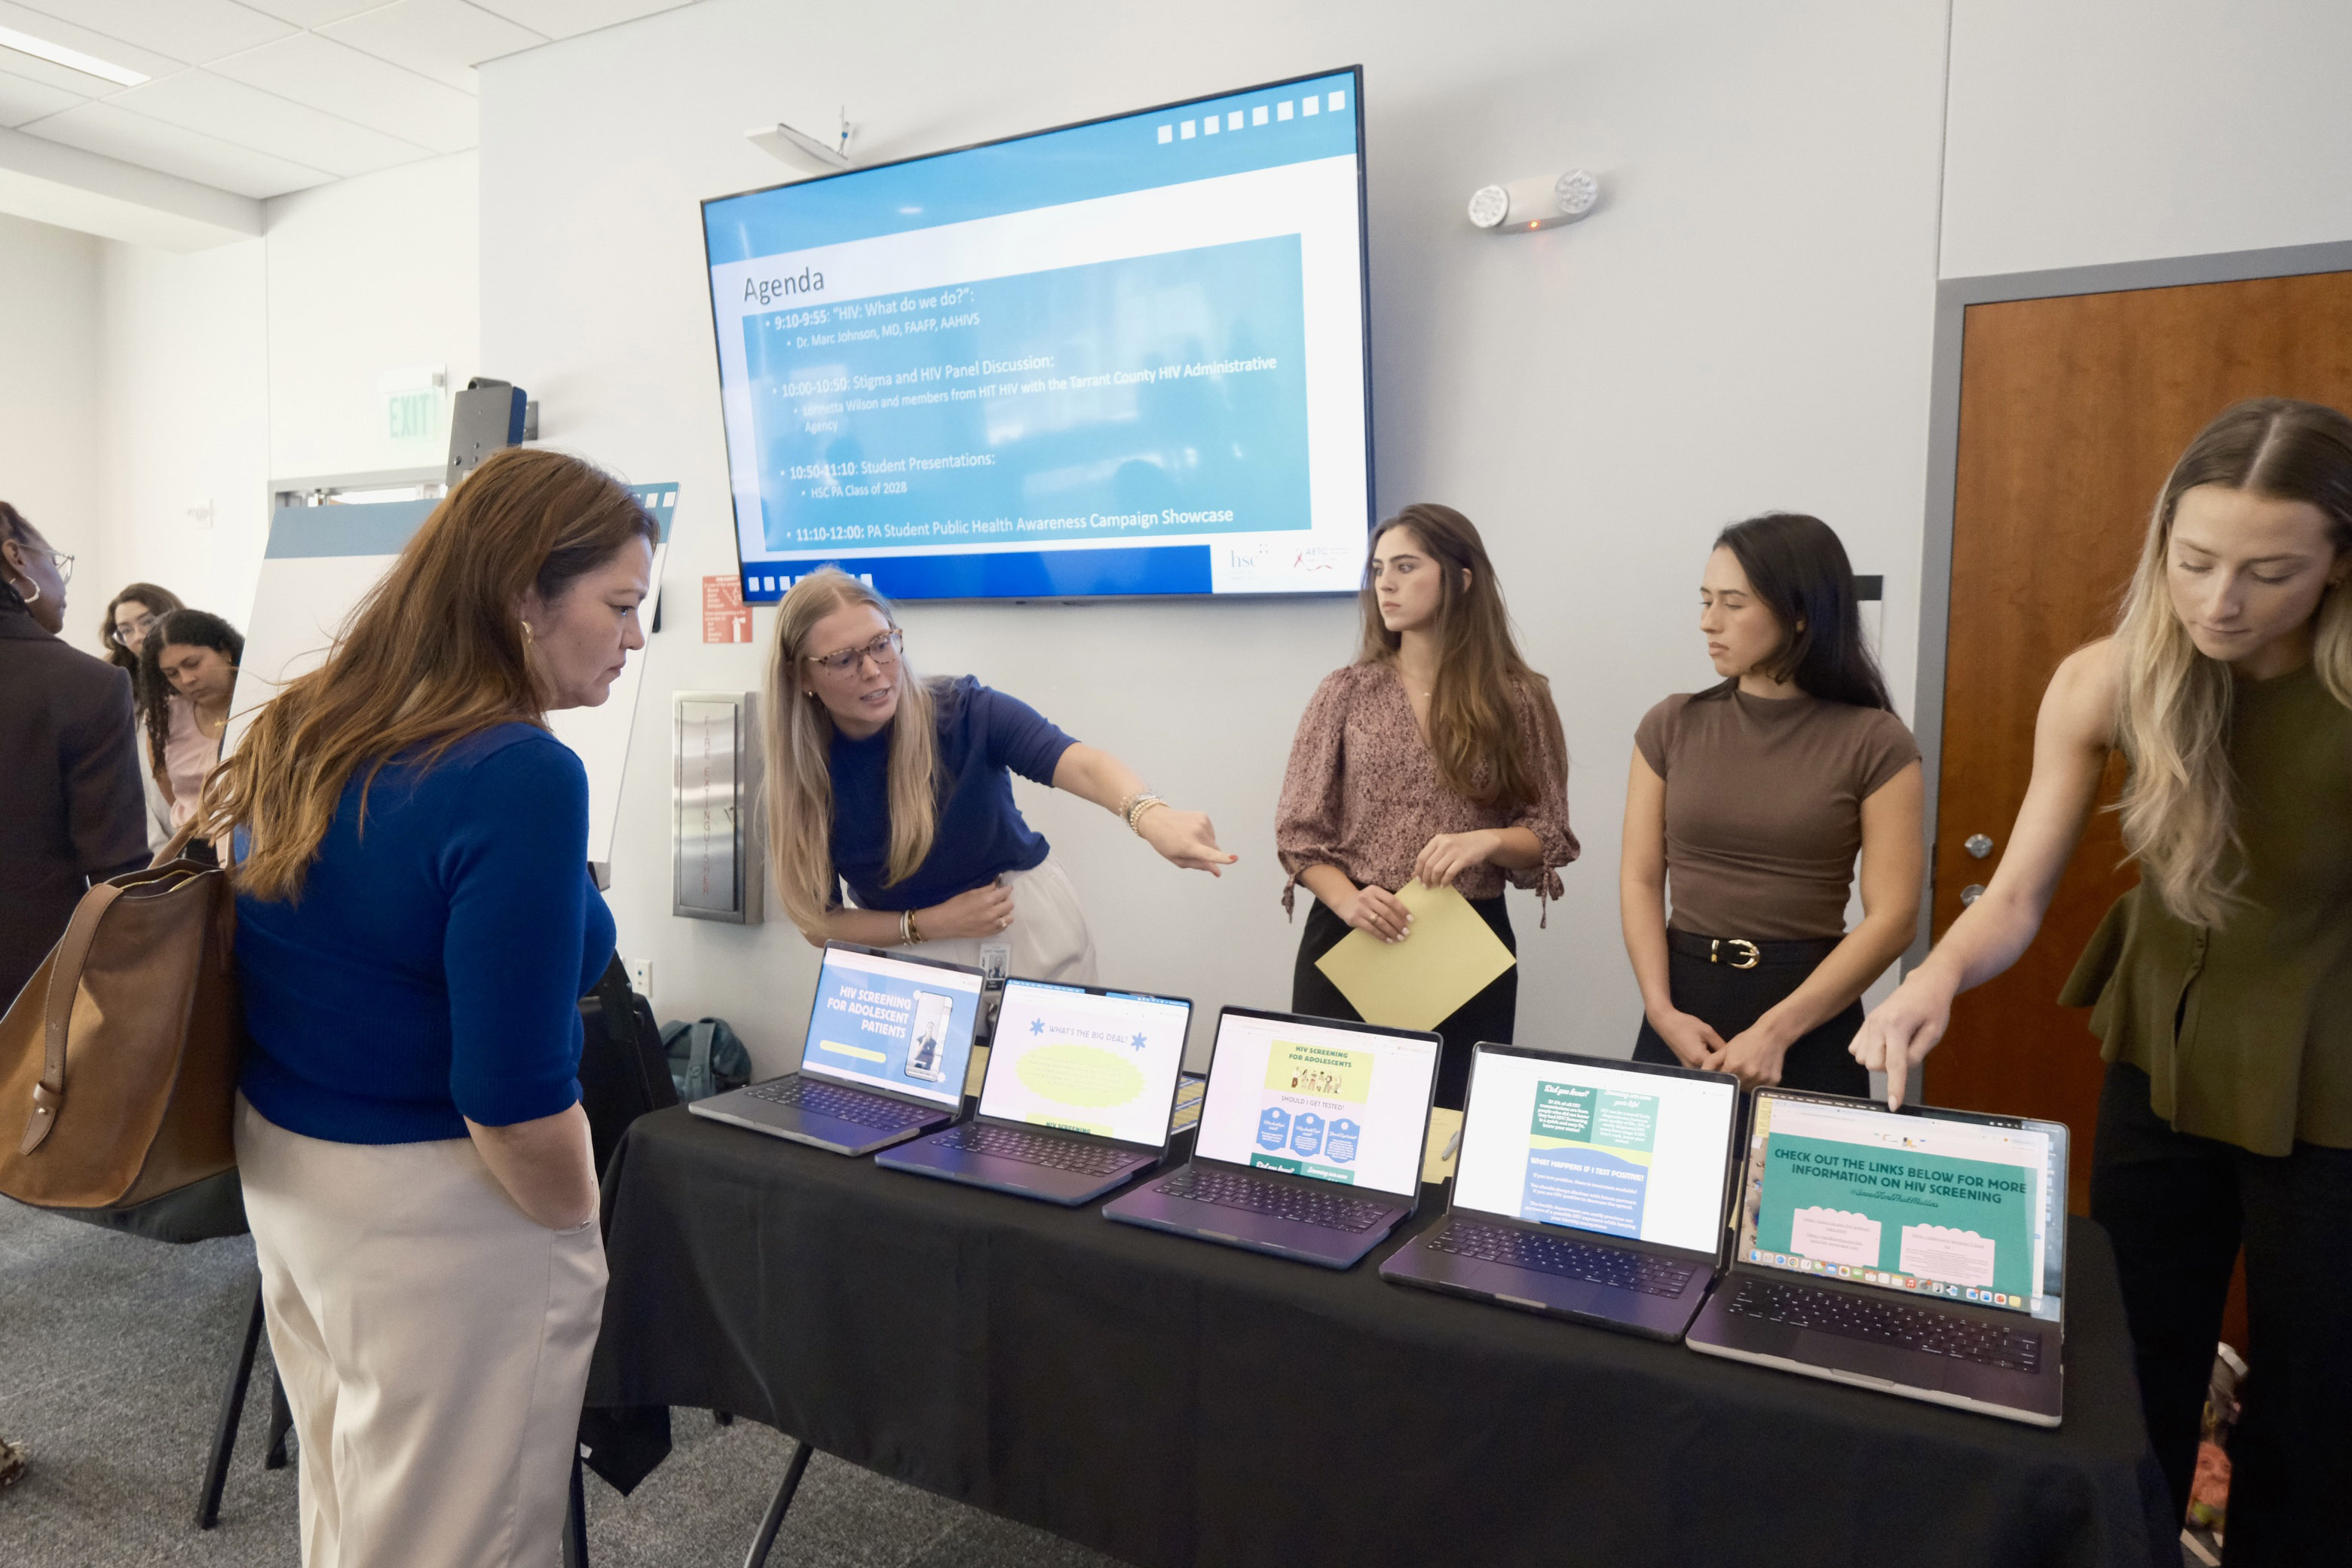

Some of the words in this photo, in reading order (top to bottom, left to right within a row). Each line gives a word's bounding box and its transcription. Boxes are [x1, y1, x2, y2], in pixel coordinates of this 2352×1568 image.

[744, 266, 824, 305] Agenda
[775, 310, 830, 331] 9:10-9:55:
[865, 301, 897, 317] What
[901, 296, 917, 312] do
[920, 297, 937, 310] we
[797, 336, 810, 349] Dr.
[812, 334, 835, 347] Marc
[838, 329, 880, 344] Johnson,
[882, 323, 902, 338] MD,
[905, 318, 939, 334] FAAFP,
[941, 312, 980, 329] AAHIVS
[782, 376, 850, 398] 10:00-10:50:
[853, 373, 892, 391] Stigma
[896, 367, 917, 384] and
[920, 365, 942, 381] HIV
[945, 360, 979, 379] Panel
[982, 355, 1055, 375] Discussion:
[846, 398, 879, 411] Wilson
[880, 394, 899, 408] and
[902, 389, 949, 406] members
[951, 387, 976, 400] from
[978, 384, 997, 398] HIT
[999, 382, 1018, 396] HIV
[1021, 380, 1046, 394] with
[1048, 377, 1067, 391] the
[1070, 372, 1111, 389] Tarrant
[1113, 369, 1156, 385] County
[1159, 365, 1181, 380] HIV
[1184, 356, 1277, 378] Administrative
[389, 393, 430, 439] EXIT
[805, 420, 838, 435] Agency
[790, 462, 858, 480] 10:50-11:10:
[861, 458, 905, 475] Student
[909, 453, 995, 471] Presentations:
[811, 486, 830, 499] HSC
[831, 485, 844, 498] PA
[846, 483, 868, 497] Class
[871, 482, 882, 495] of
[884, 481, 908, 495] 2028
[796, 524, 865, 542] 11:10-12:00:
[868, 524, 882, 537] PA
[884, 521, 930, 538] Student
[933, 518, 969, 536] Public
[972, 516, 1013, 534] Health
[1016, 515, 1087, 531] Awareness
[1089, 510, 1158, 530] Campaign
[1162, 507, 1234, 526] Showcase
[827, 997, 847, 1012] FOR
[848, 1001, 910, 1024] ADOLESCENT
[840, 985, 857, 999] HIV
[858, 989, 912, 1010] SCREENING
[861, 1018, 907, 1039] PATIENTS
[1049, 1024, 1074, 1036] WHAT'S
[1076, 1029, 1090, 1038] THE
[1092, 1031, 1105, 1040] BIG
[1304, 1055, 1352, 1068] ADOLESCENTS
[1309, 1048, 1349, 1058] SCREENING
[1282, 1095, 1305, 1104] SHOULD
[1531, 1156, 1550, 1166] WHAT
[1551, 1160, 1583, 1171] HAPPENS
[1595, 1167, 1610, 1176] TEST
[1775, 1148, 1811, 1163] CHECK
[1815, 1154, 1839, 1166] OUT
[1842, 1157, 1865, 1170] THE
[1868, 1162, 1904, 1175] LINKS
[1907, 1167, 1954, 1183] BELOW
[1957, 1174, 1984, 1187] FOR
[1987, 1178, 2026, 1194] MORE
[1792, 1163, 1877, 1186] INFORMATION
[1881, 1177, 1900, 1190] ON
[1904, 1180, 1927, 1193] HIV
[1930, 1184, 2002, 1204] SCREENING
